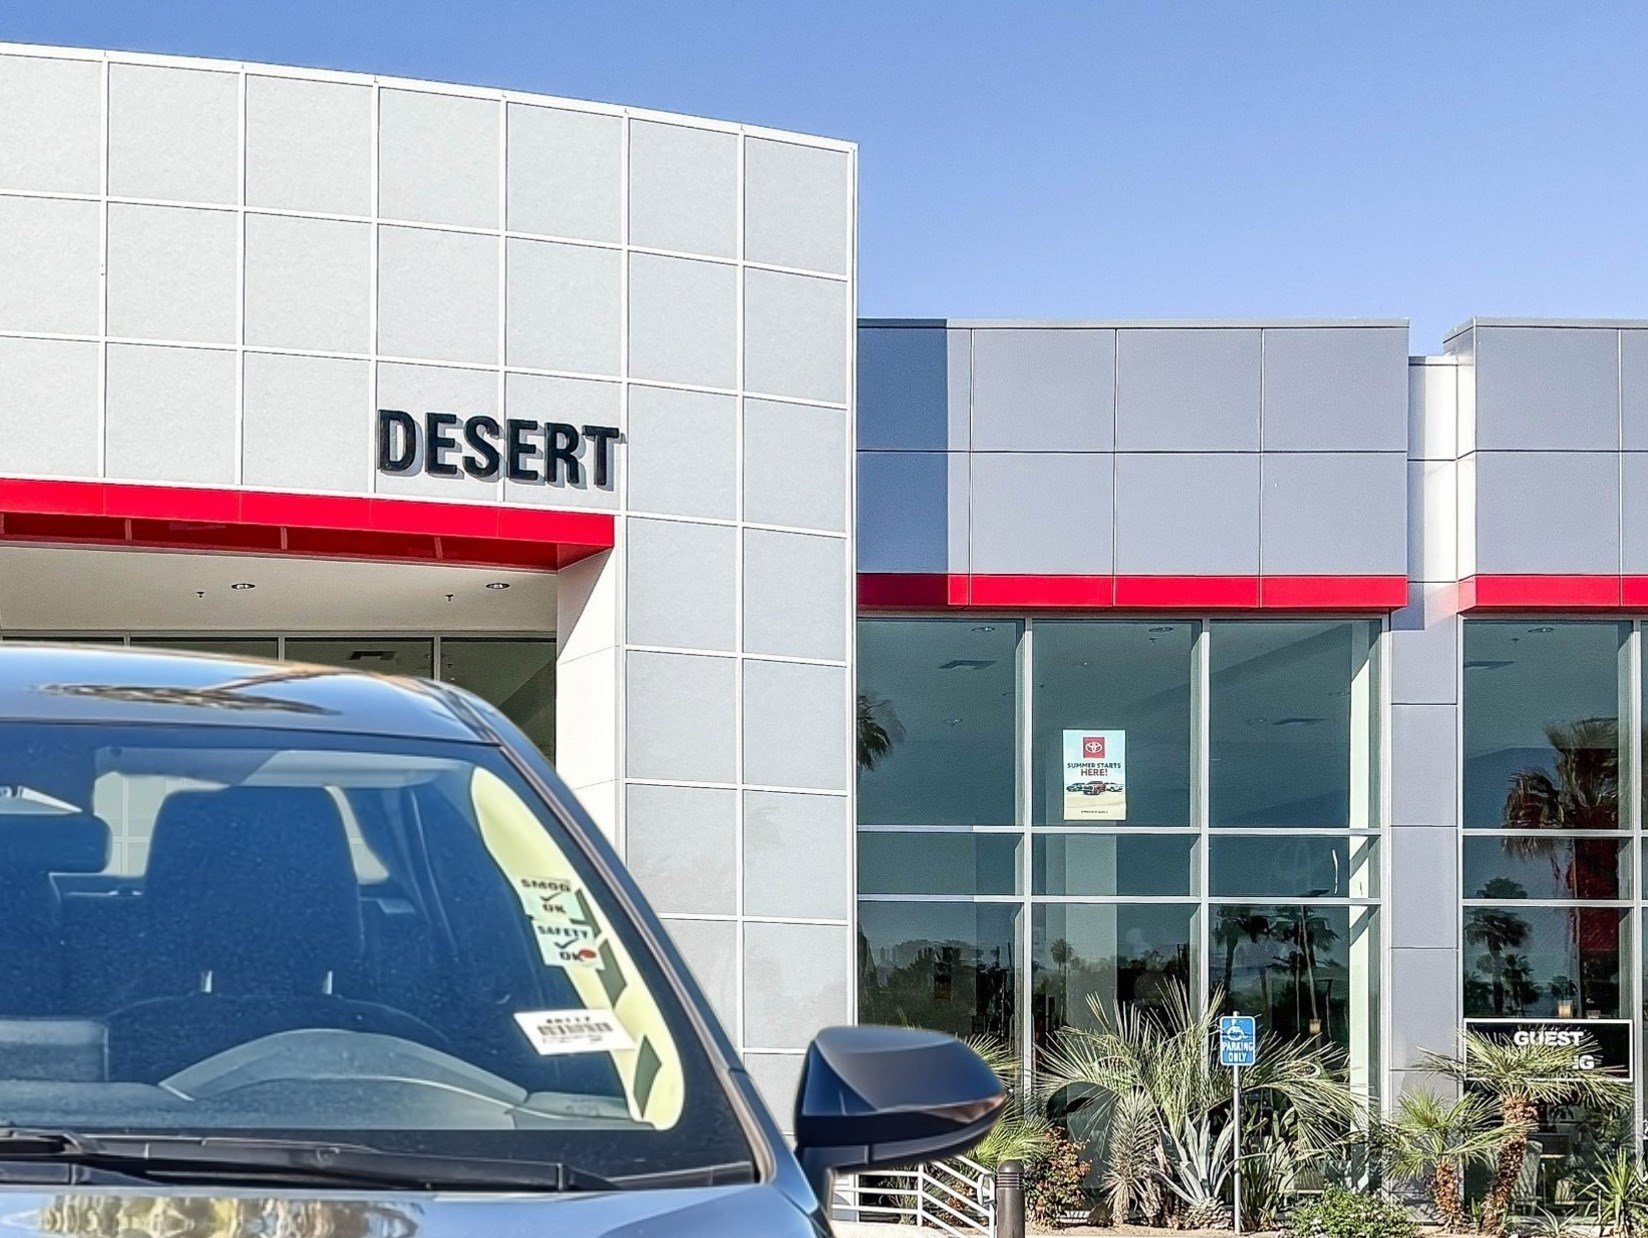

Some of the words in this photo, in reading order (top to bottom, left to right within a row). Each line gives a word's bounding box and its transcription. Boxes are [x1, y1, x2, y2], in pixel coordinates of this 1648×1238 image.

[377, 409, 620, 487] DESERT
[521, 879, 571, 892] SMOG
[537, 926, 588, 939] SAFETY
[1513, 1031, 1584, 1047] GUEST
[1222, 1041, 1253, 1052] PARKING
[1228, 1051, 1247, 1062] ONLY
